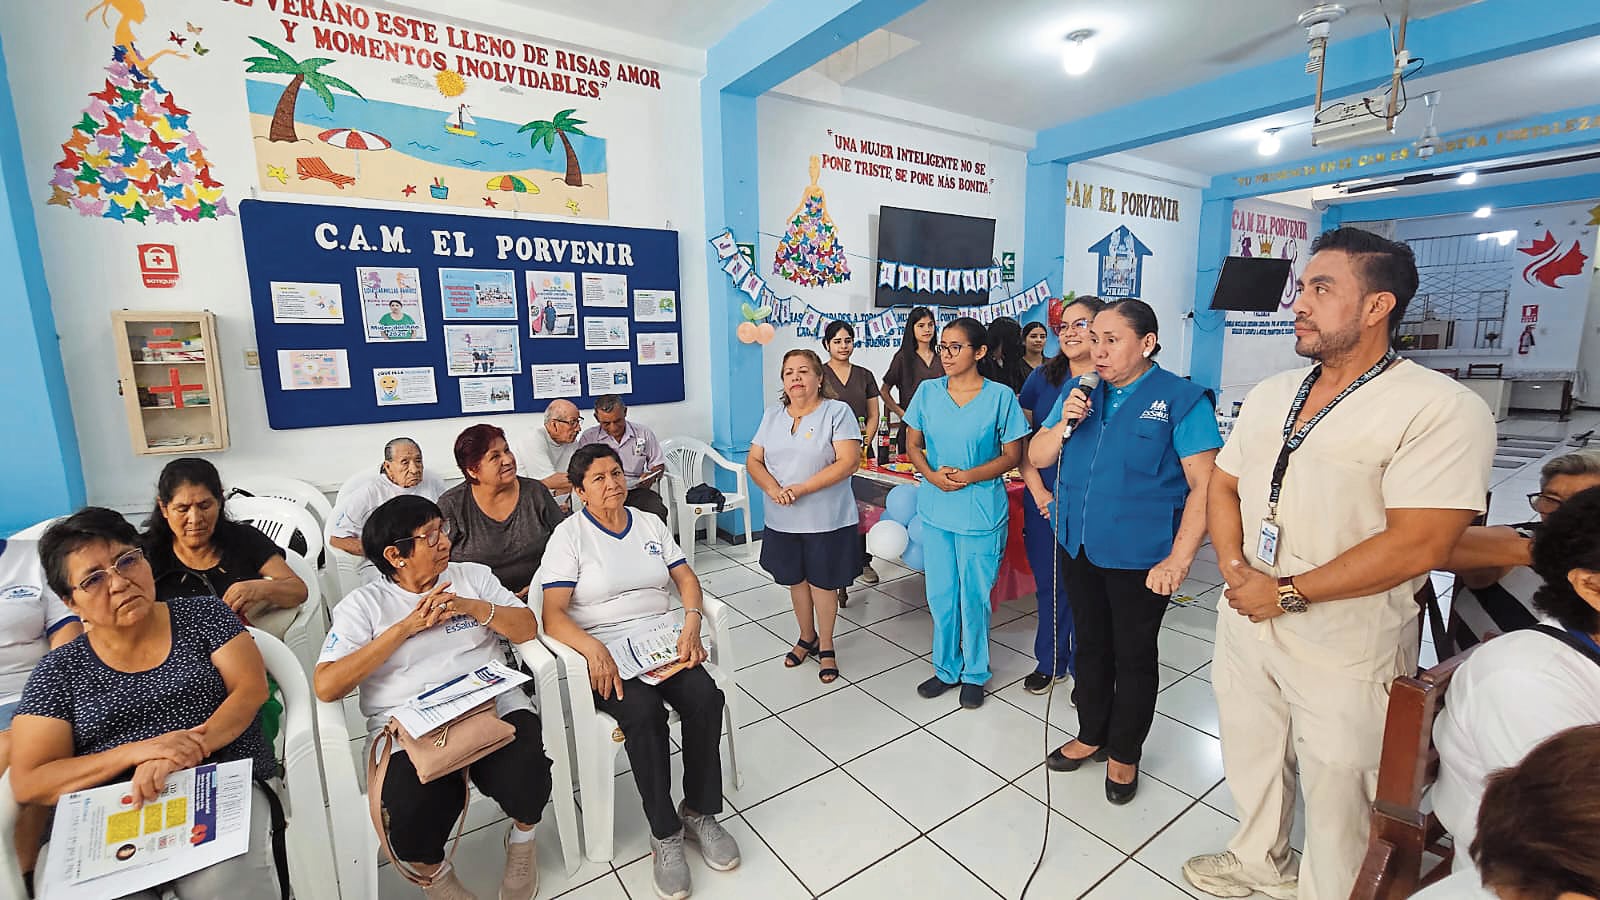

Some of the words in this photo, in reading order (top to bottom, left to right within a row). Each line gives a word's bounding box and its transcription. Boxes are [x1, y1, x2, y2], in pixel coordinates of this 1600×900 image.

[280, 19, 298, 43] Y
[313, 26, 447, 71] MOMENTOS
[375, 12, 438, 44] ESTE
[446, 26, 516, 59] LLENO
[523, 43, 549, 67] DE
[617, 64, 661, 90] AMOR
[821, 154, 851, 172] PONE
[895, 168, 907, 183] SE
[910, 170, 934, 187] PONE
[860, 140, 894, 160] MUJER
[897, 147, 958, 171] INTELIGENTE
[960, 160, 972, 174] NO
[974, 162, 986, 176] SE
[1099, 186, 1117, 213] EL
[1121, 192, 1179, 222] PORVENIR
[1232, 208, 1254, 232] CAM
[1270, 216, 1307, 240] PORVENIR
[314, 222, 412, 254] C.A.M.
[432, 230, 474, 258] EL
[496, 235, 634, 266] PORVENIR
